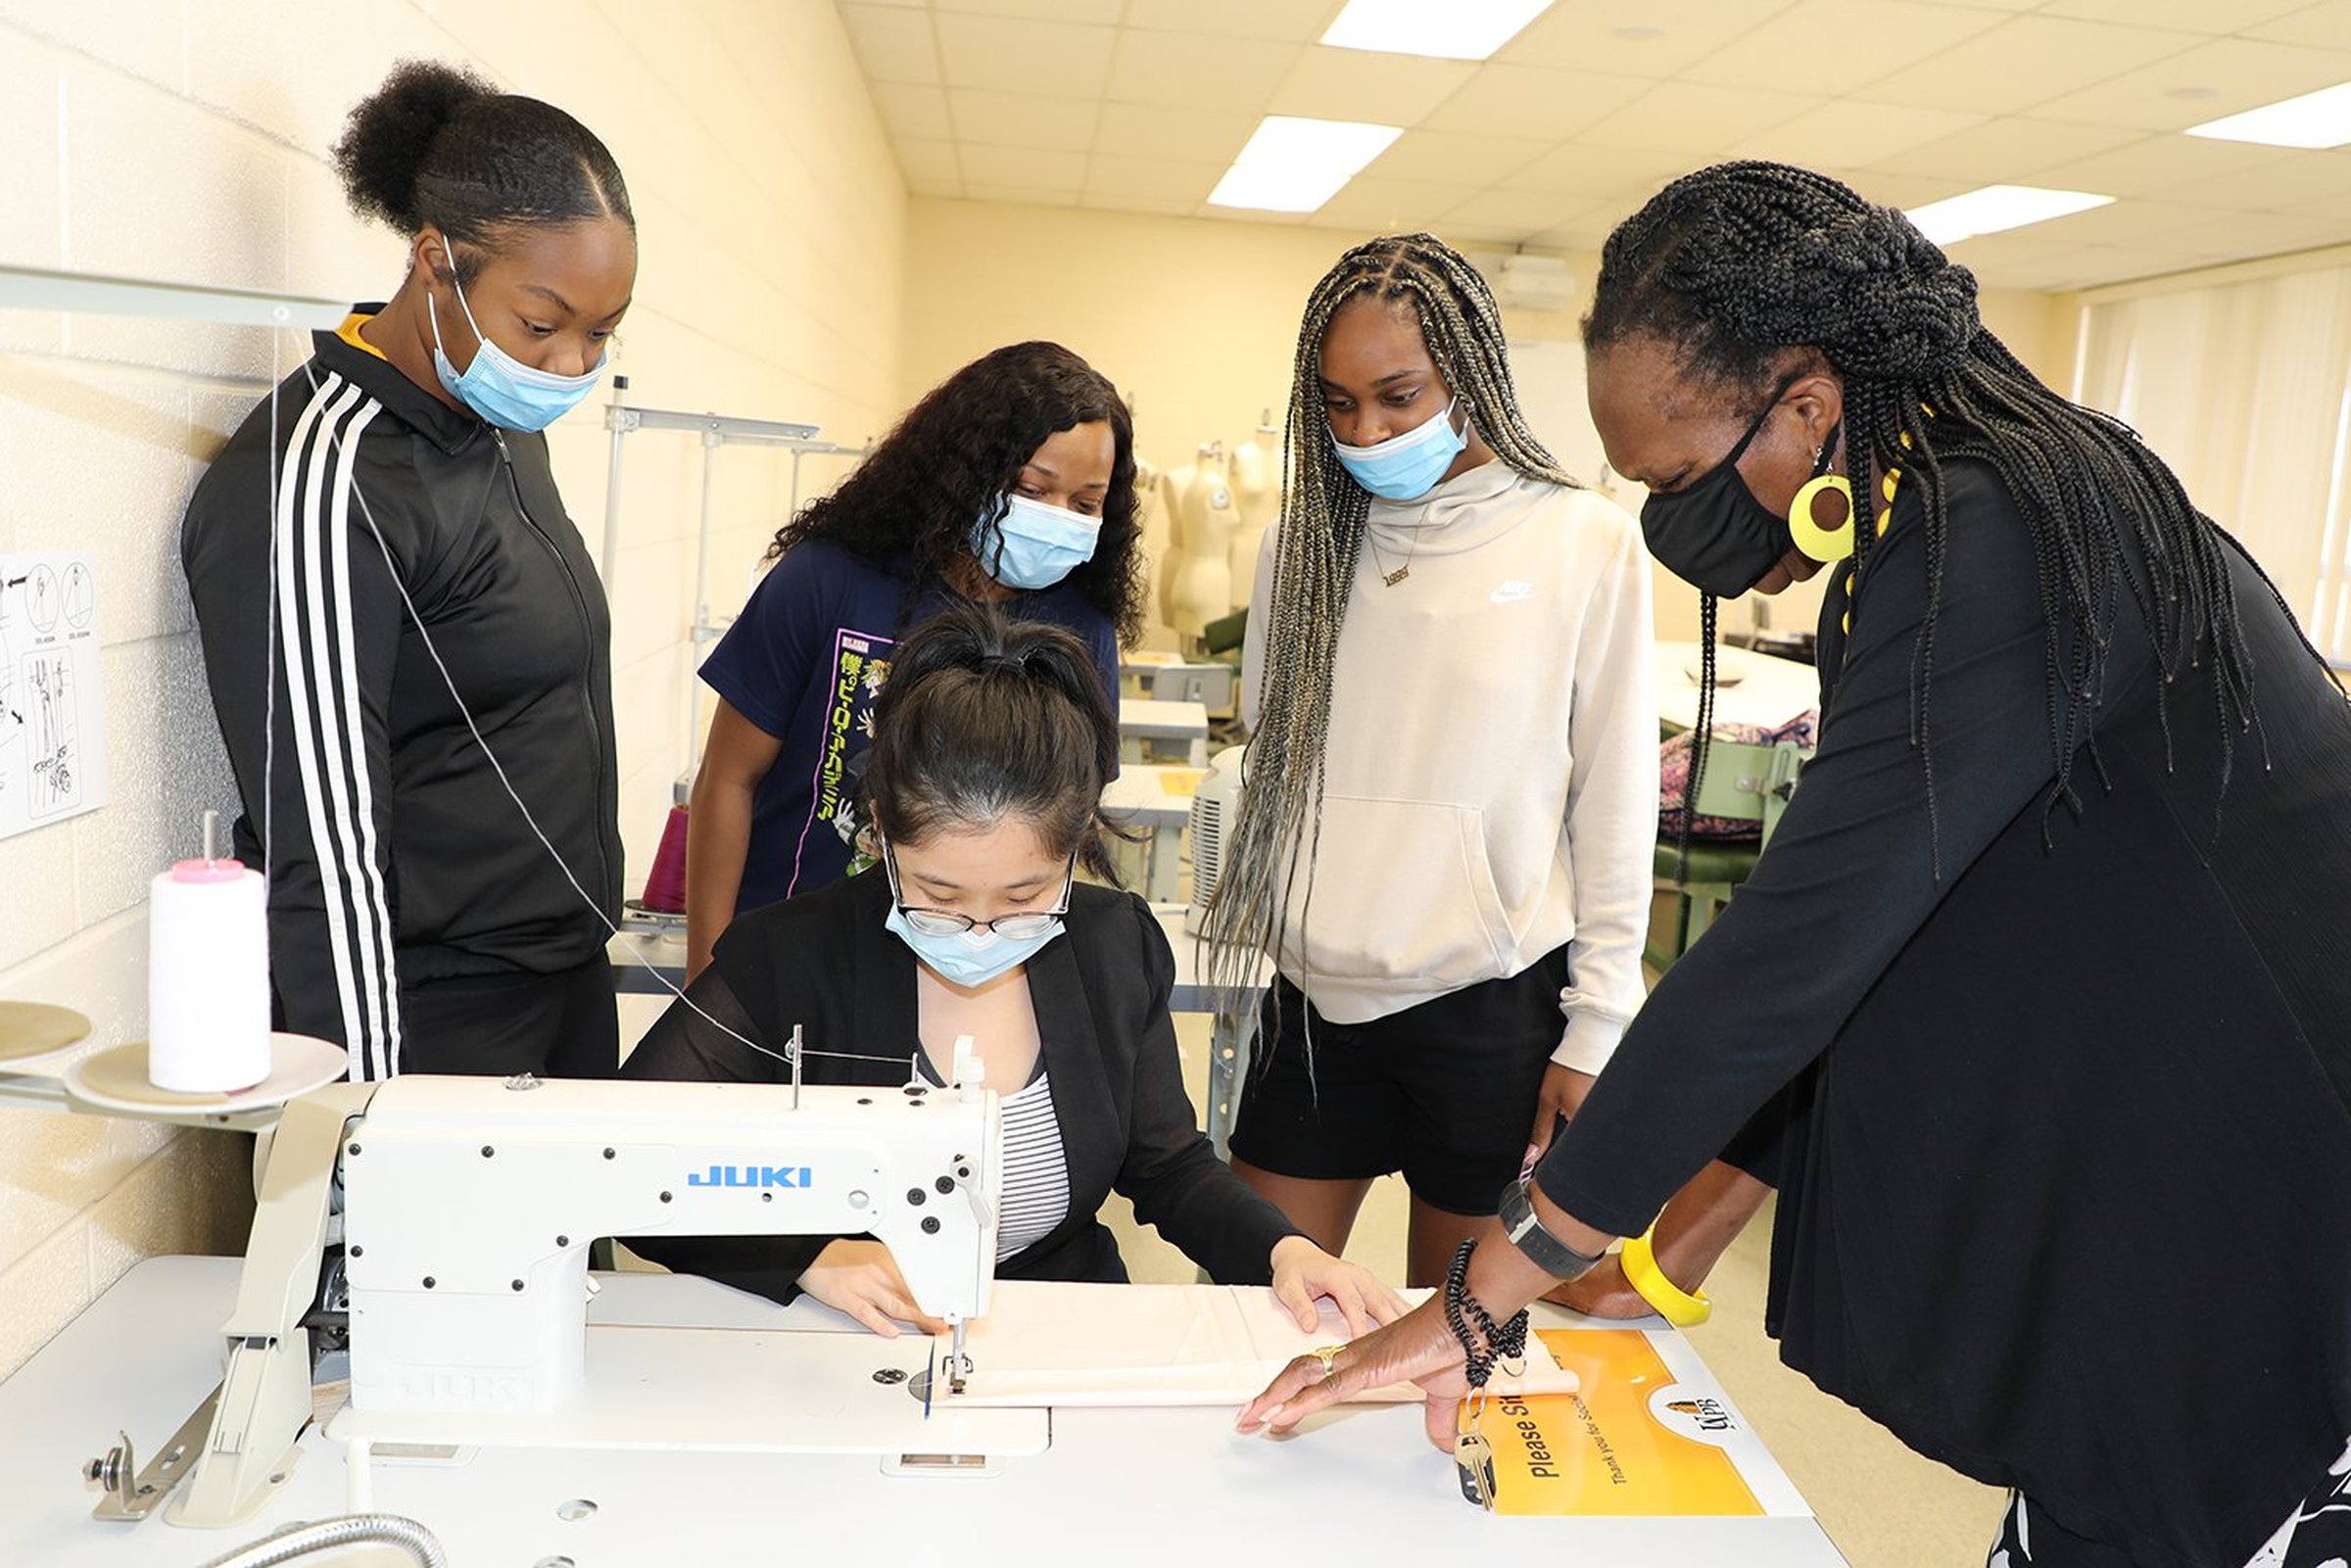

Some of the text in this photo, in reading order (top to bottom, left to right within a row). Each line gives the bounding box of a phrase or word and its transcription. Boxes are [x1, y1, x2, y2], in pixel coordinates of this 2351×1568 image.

[688, 1165, 811, 1188] JUKI
[392, 1372, 535, 1402] JUKI
[1584, 1422, 1600, 1436] for
[1516, 1421, 1559, 1478] Please
[1595, 1437, 1613, 1454] you
[1603, 1455, 1627, 1485] Thank
